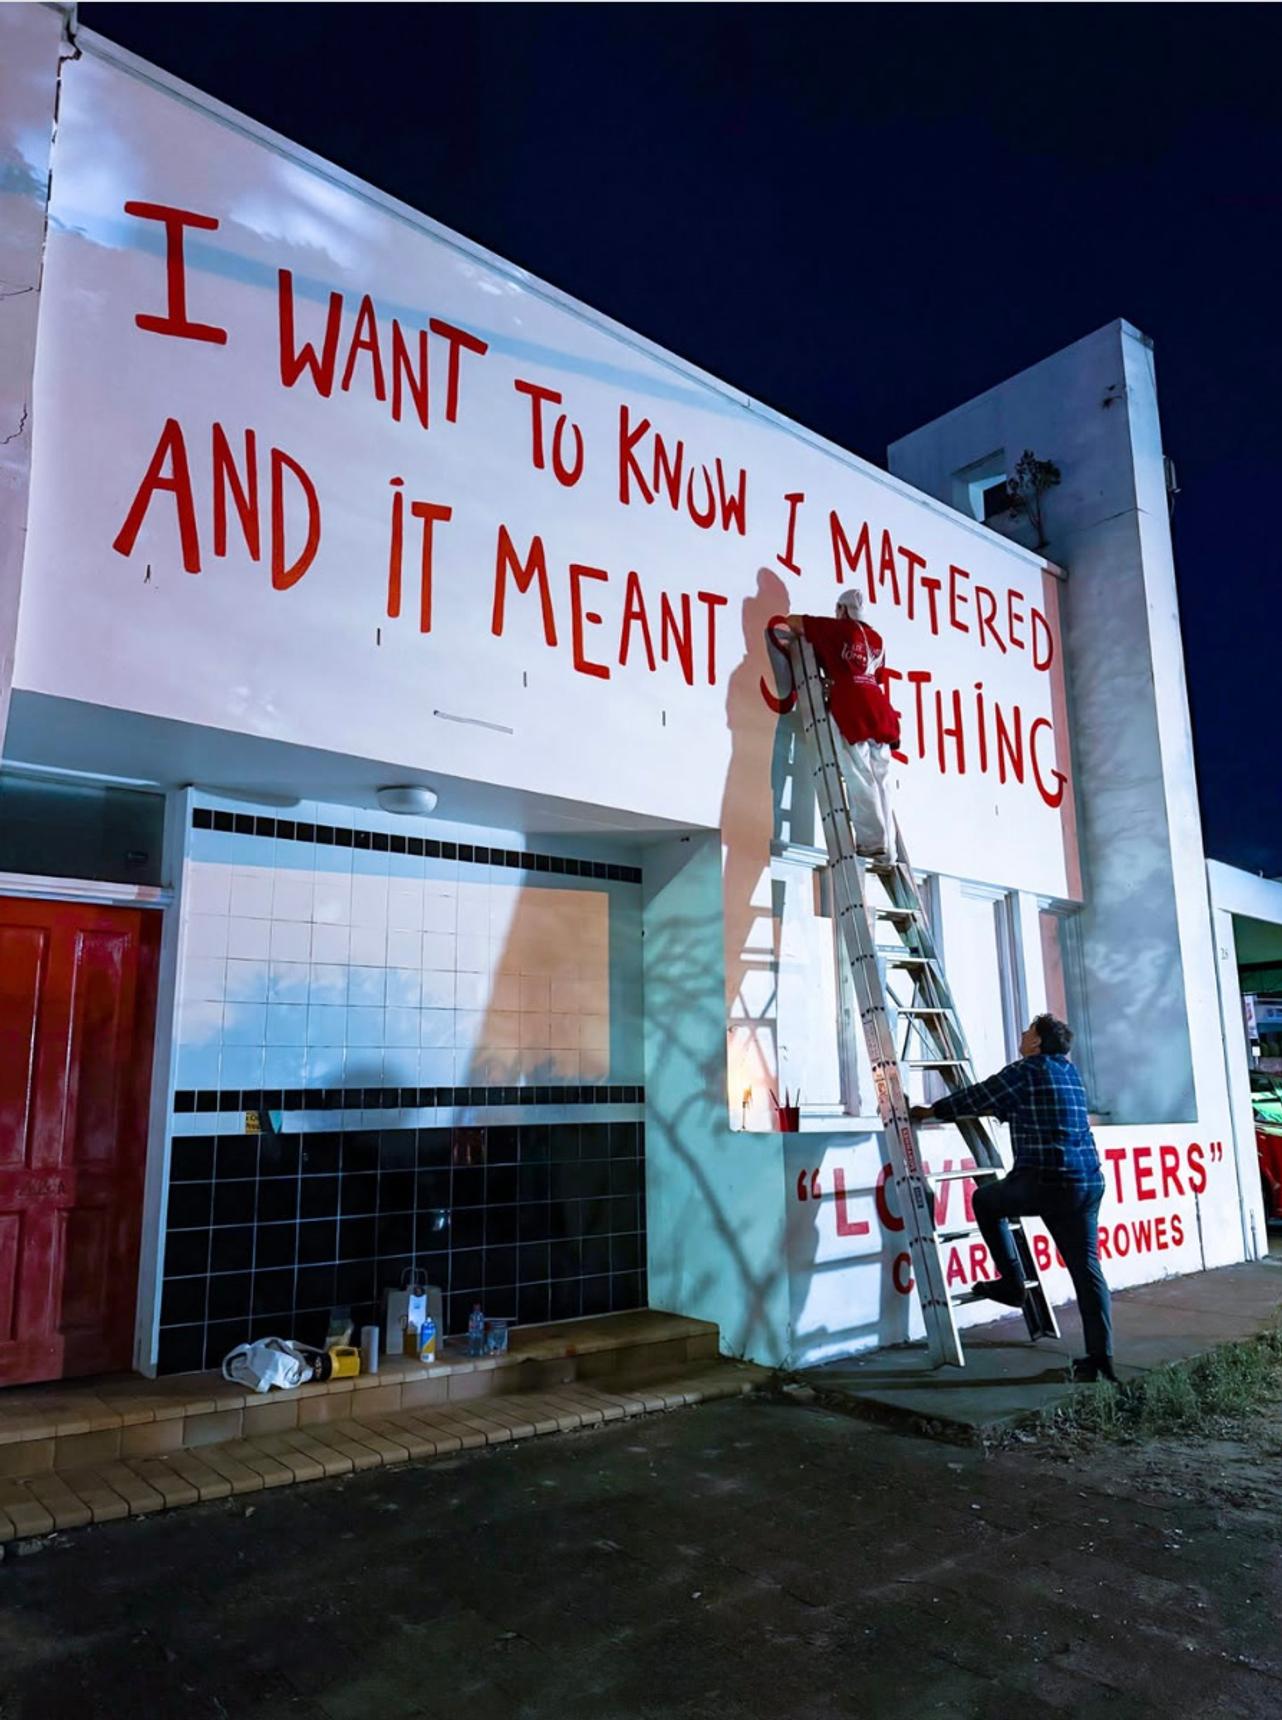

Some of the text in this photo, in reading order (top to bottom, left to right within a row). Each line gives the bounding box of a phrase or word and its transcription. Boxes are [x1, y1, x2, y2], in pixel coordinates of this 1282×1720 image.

[112, 418, 321, 592] AND
[491, 524, 729, 687] MEANT
[124, 201, 1055, 672] I WANT TO KNOW I MATTERED
[892, 1213, 1185, 1295] CAR BROWES
